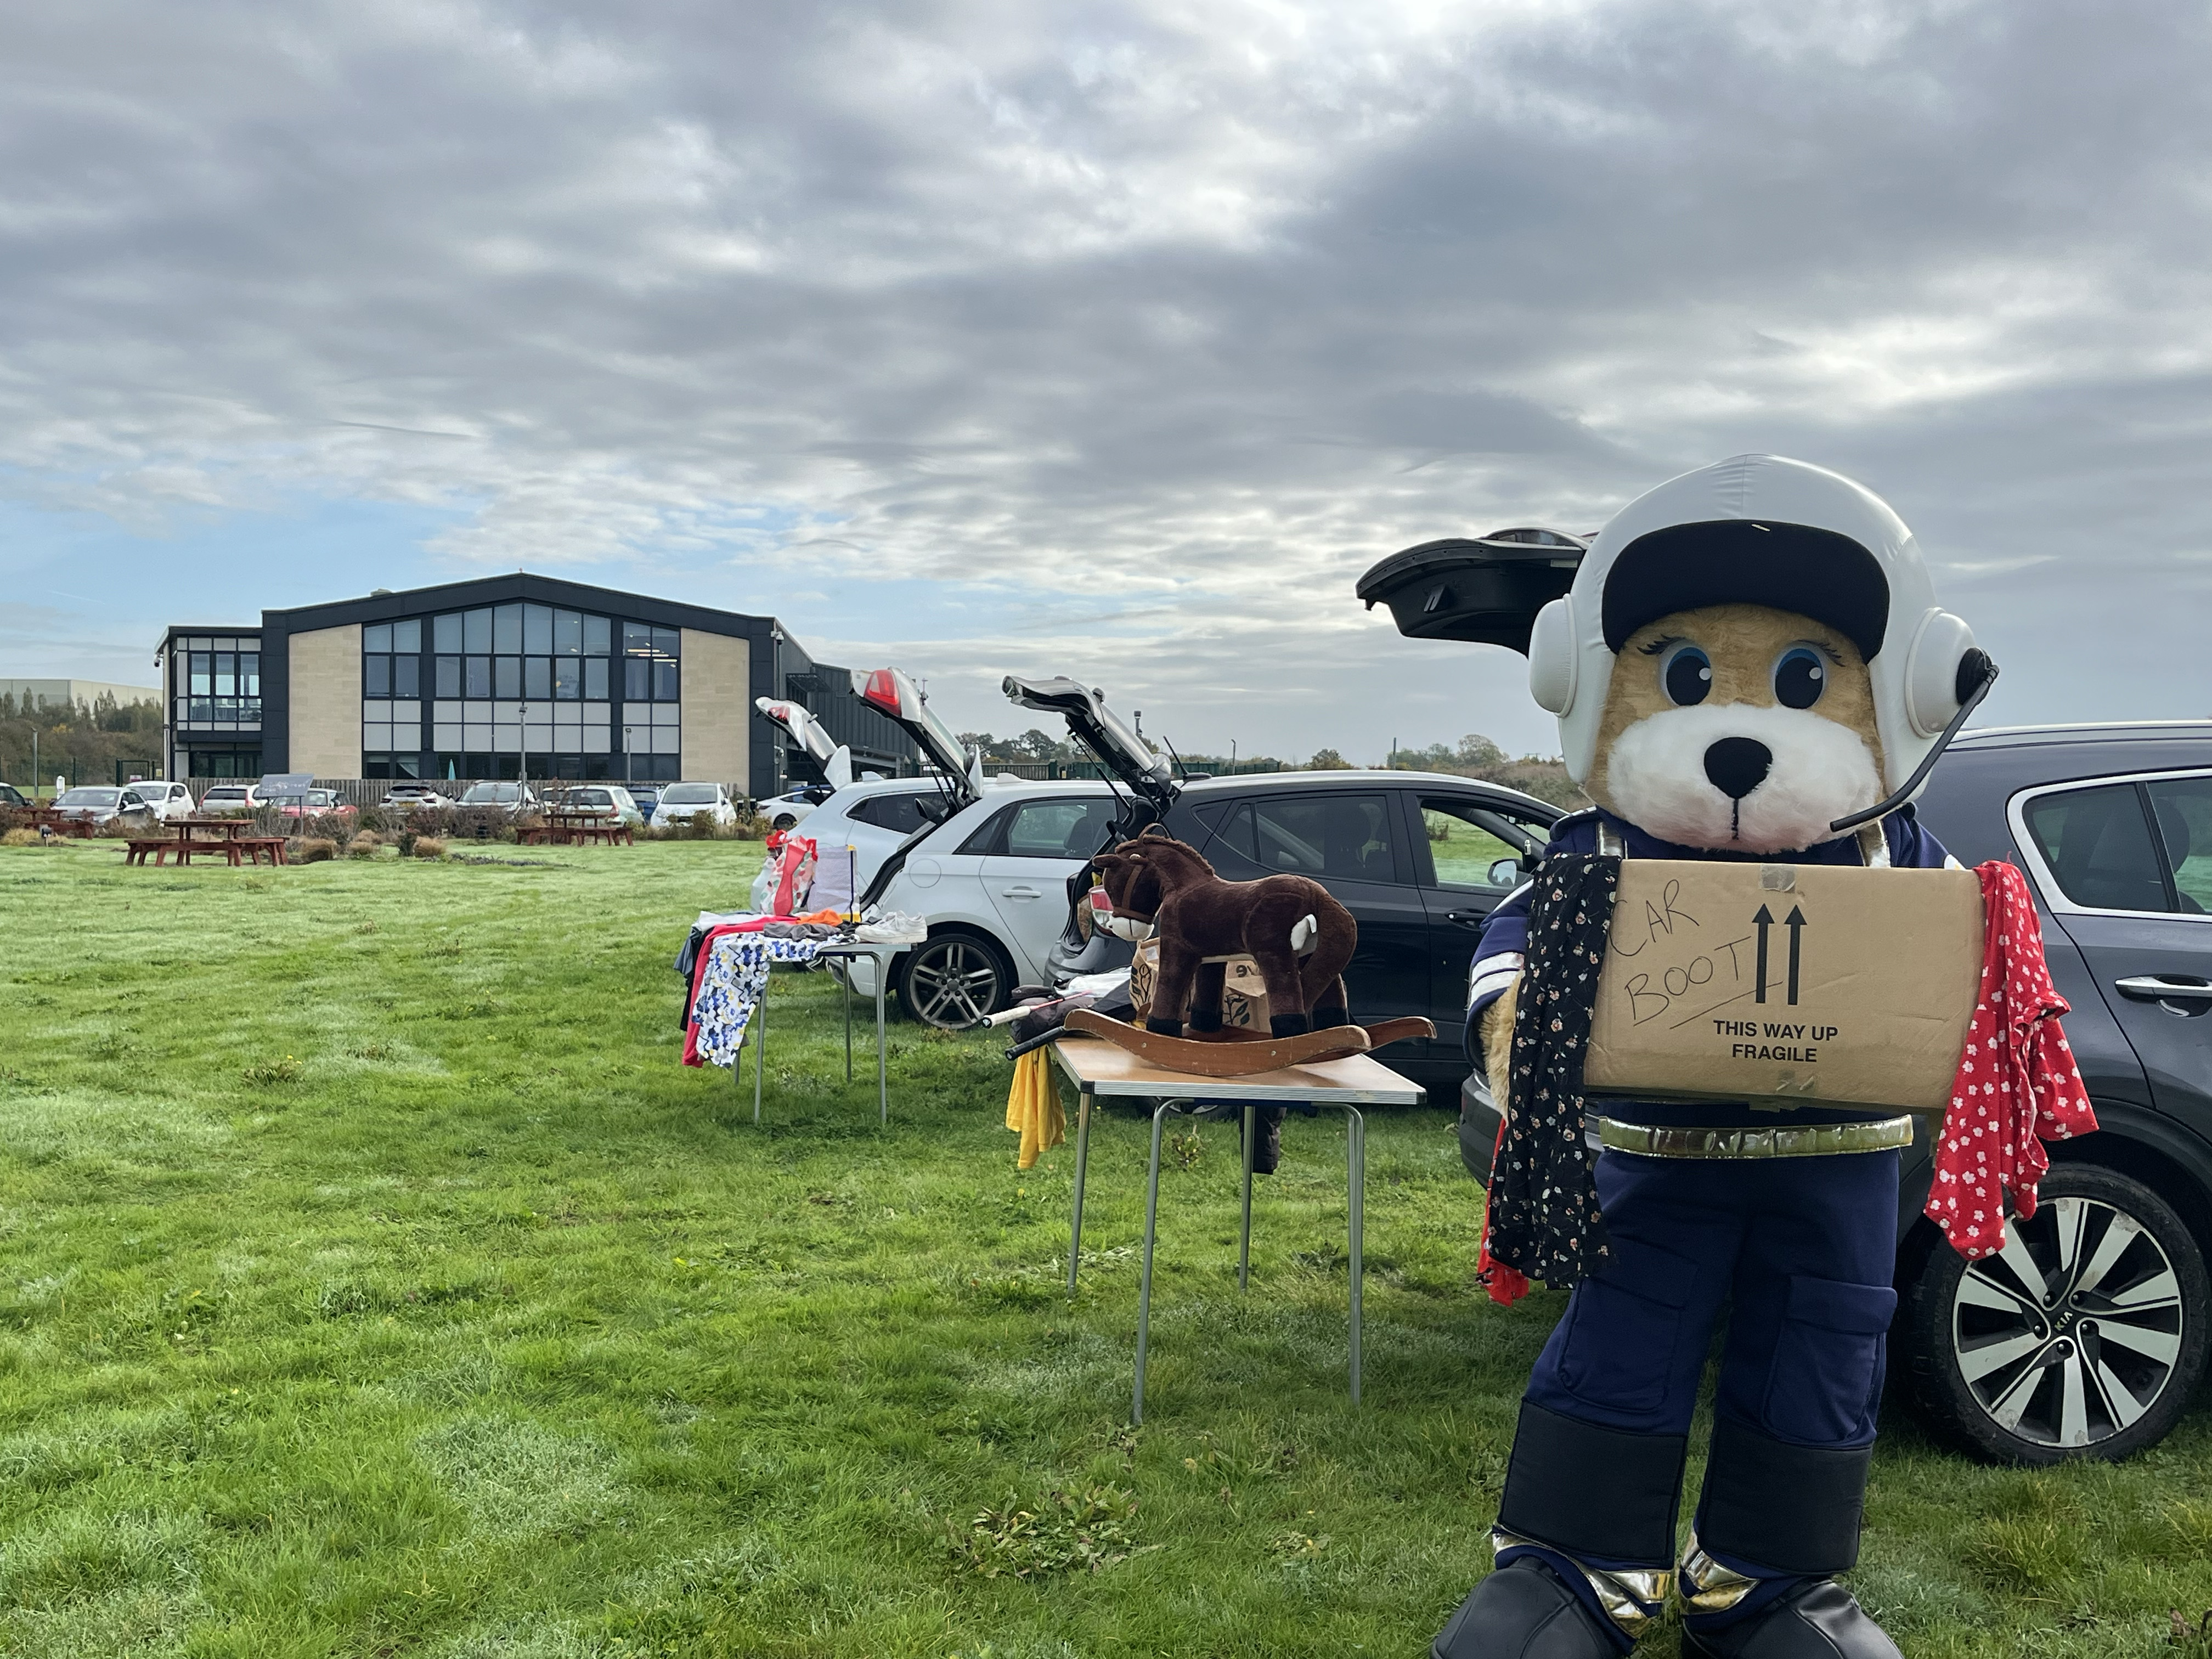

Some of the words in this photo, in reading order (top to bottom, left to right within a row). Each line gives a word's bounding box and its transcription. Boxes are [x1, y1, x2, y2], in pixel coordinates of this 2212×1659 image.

[1609, 879, 1700, 957] CAR
[1624, 935, 1752, 1027] BOOT
[1713, 1019, 1758, 1037] THIS
[1763, 1023, 1806, 1040] WAY
[1812, 1025, 1838, 1041] UP
[1732, 1043, 1818, 1063] FRAGILE
[2054, 1311, 2073, 1331] KIA
